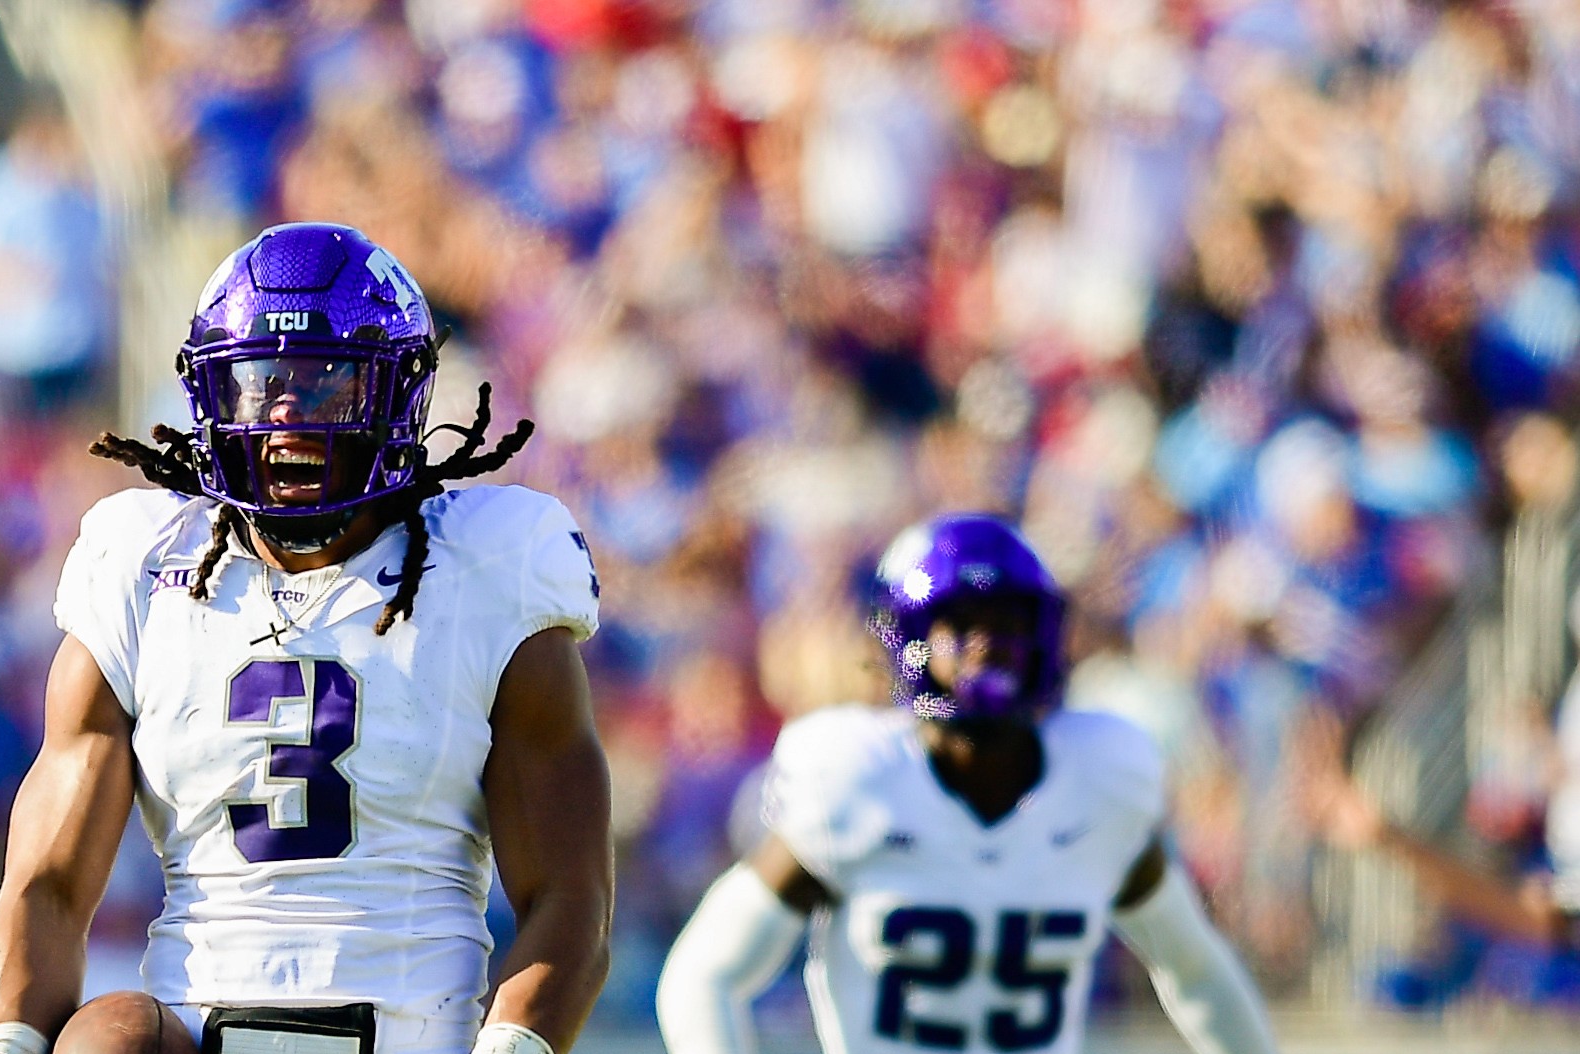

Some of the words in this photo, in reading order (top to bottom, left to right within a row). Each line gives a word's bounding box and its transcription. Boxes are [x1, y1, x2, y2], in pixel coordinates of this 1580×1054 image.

[265, 311, 309, 332] TCU
[273, 589, 308, 604] TCU
[223, 655, 364, 864] 3
[874, 903, 1089, 1054] 25
